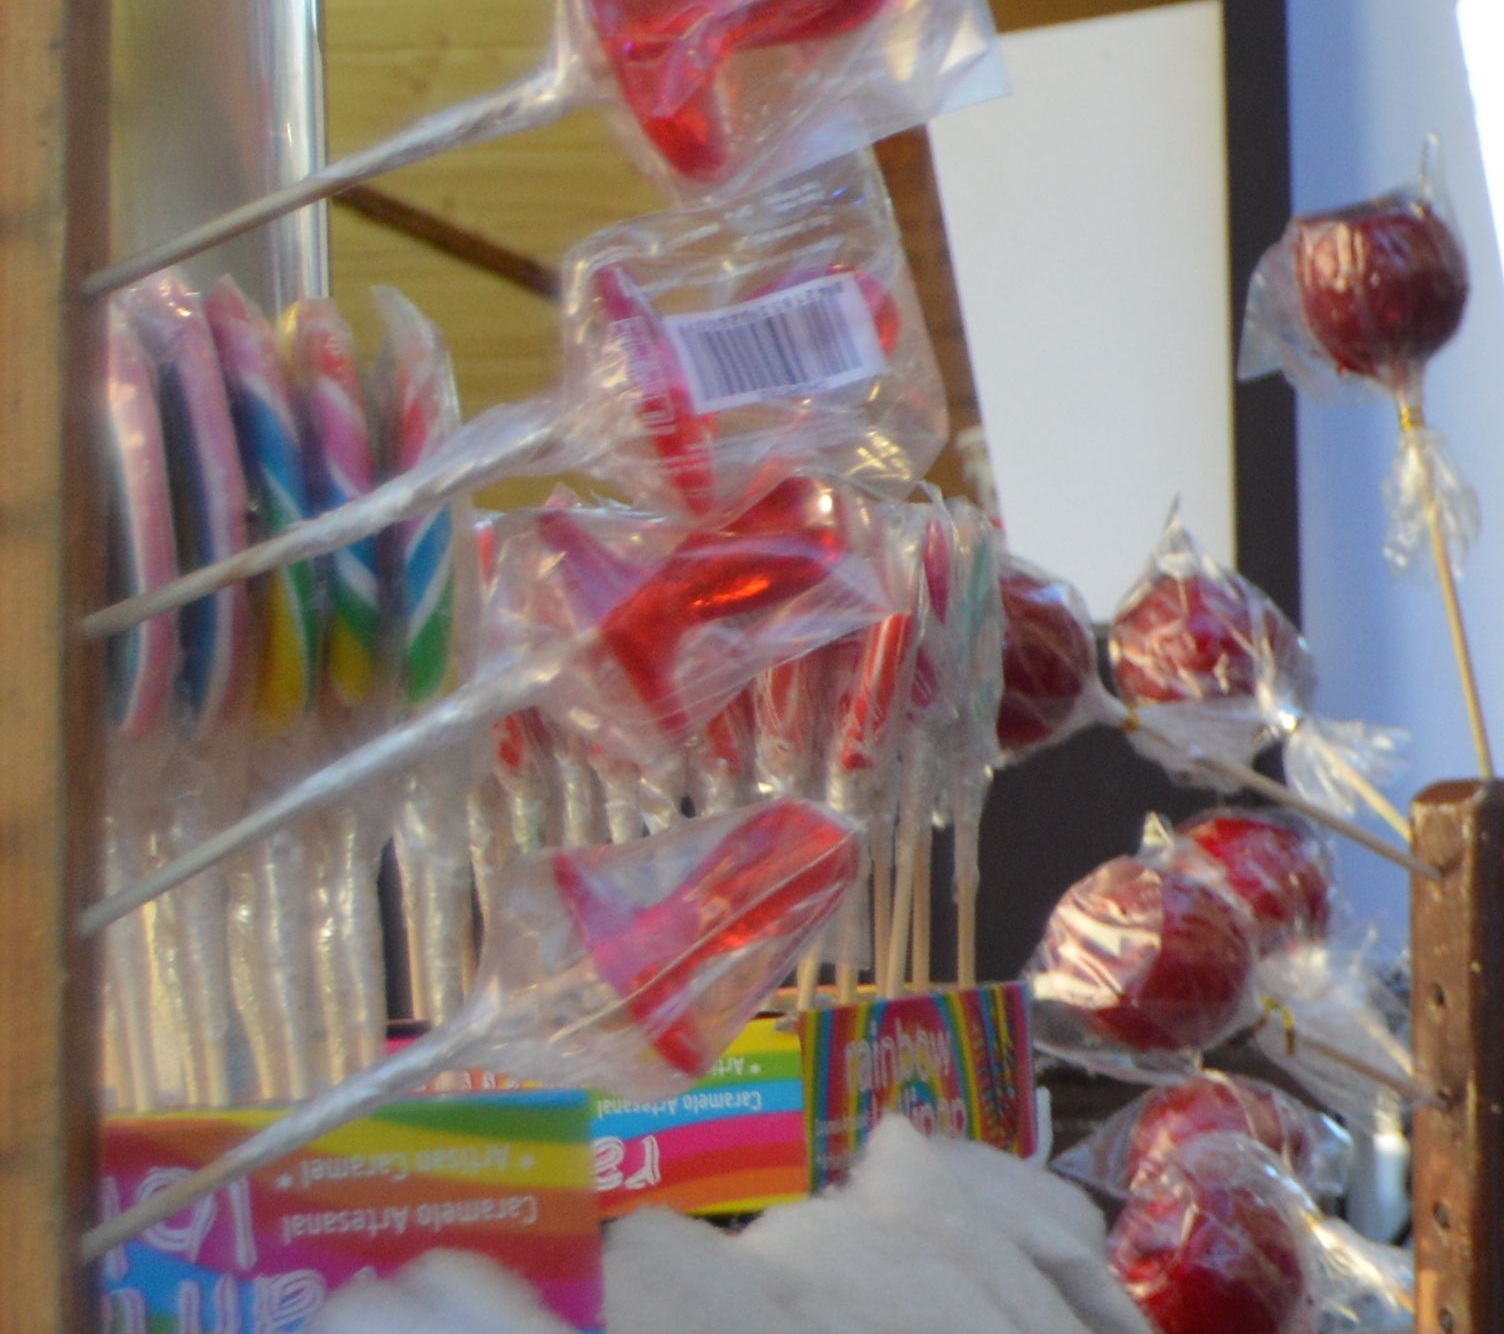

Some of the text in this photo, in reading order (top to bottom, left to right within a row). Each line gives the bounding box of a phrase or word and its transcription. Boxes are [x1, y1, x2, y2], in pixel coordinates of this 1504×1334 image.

[682, 1089, 763, 1116] Caramelo
[301, 1149, 408, 1189] Caramel
[278, 1193, 540, 1244] Caramelo Artesanal
